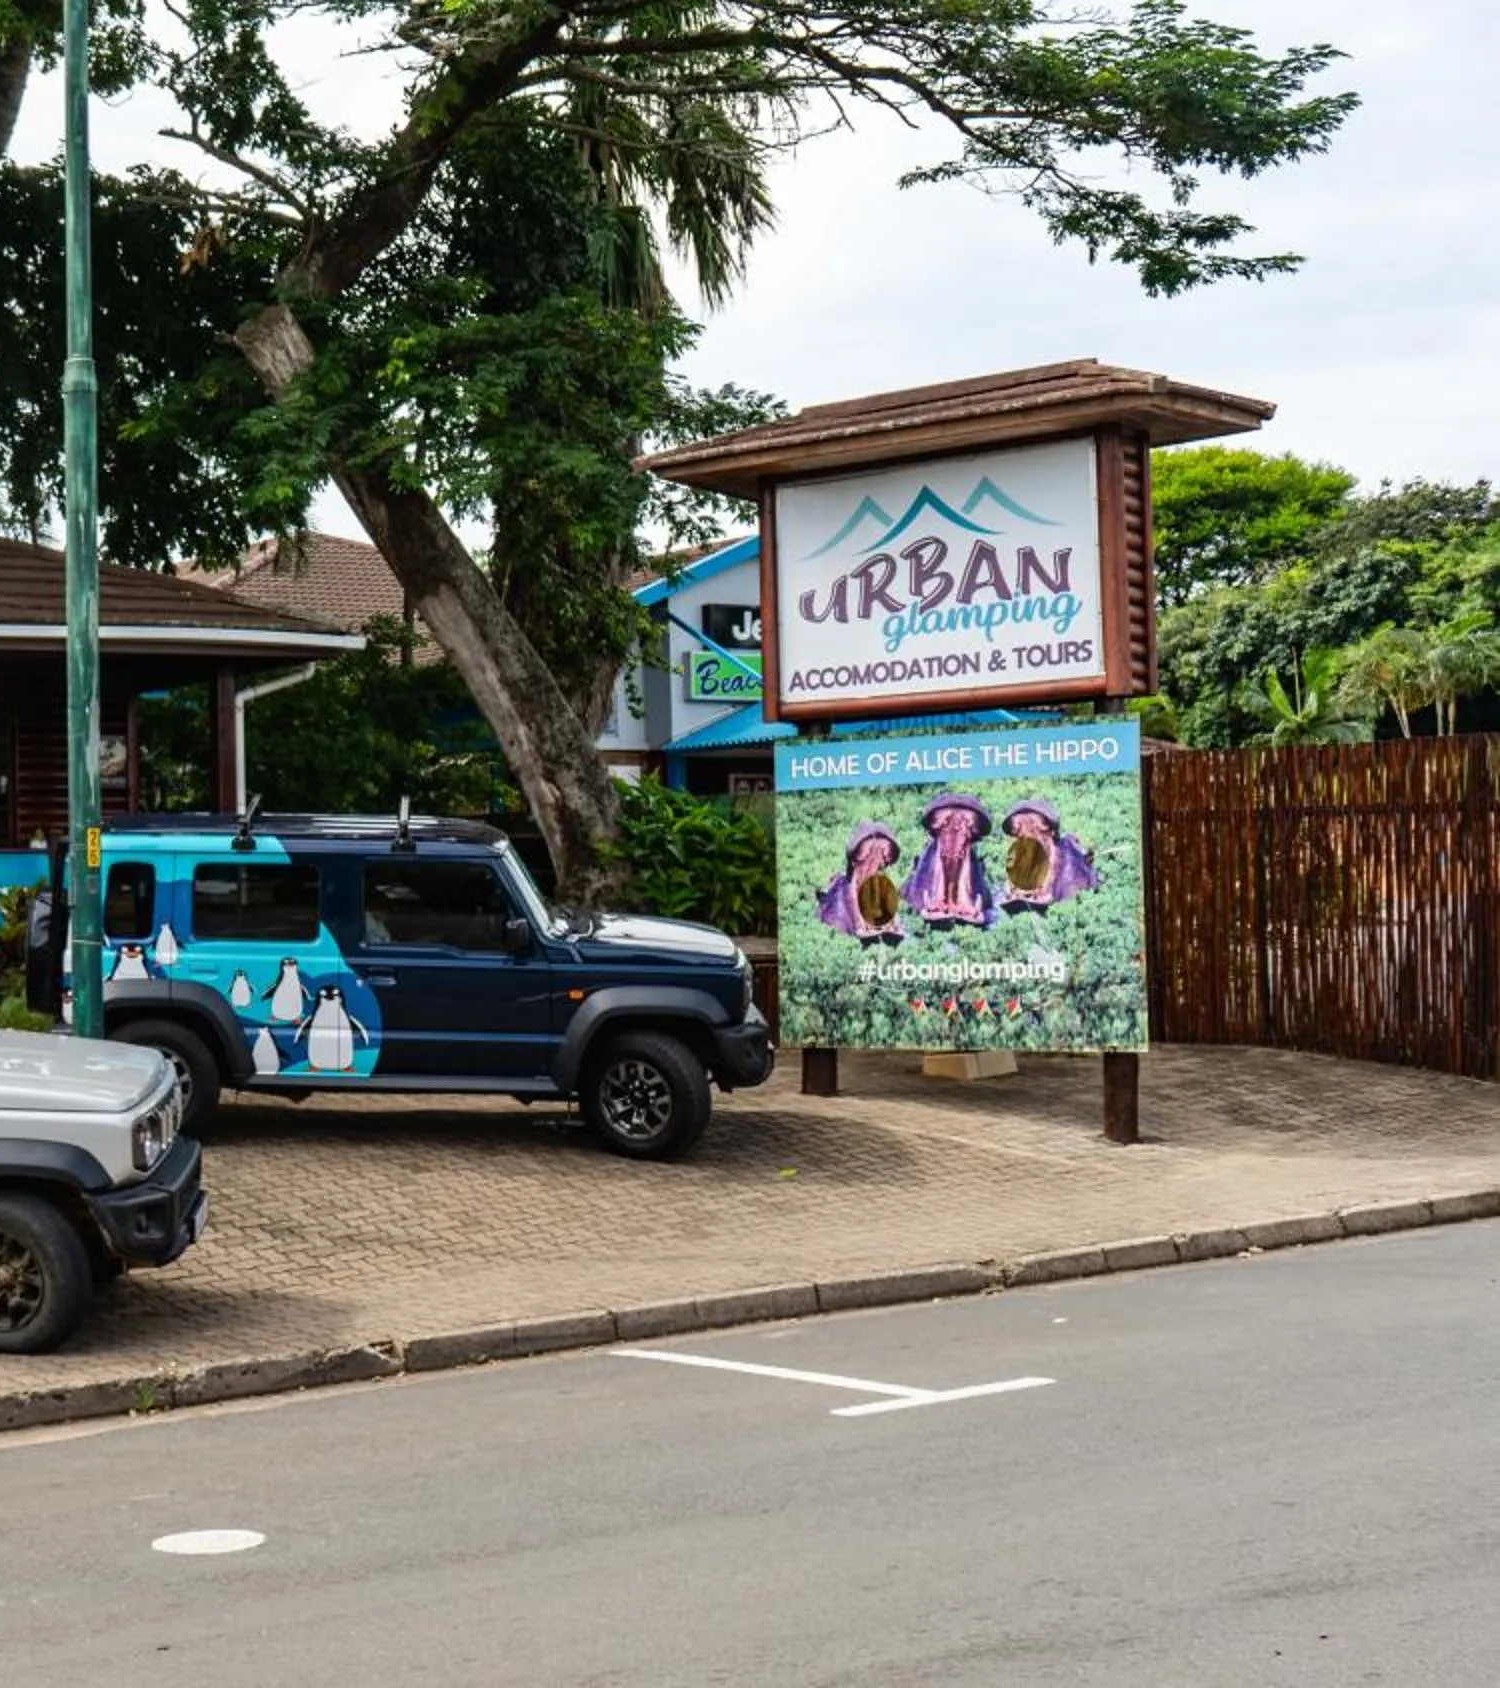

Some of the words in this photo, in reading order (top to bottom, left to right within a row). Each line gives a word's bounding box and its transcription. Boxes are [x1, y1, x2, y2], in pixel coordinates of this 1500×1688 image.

[798, 536, 1073, 623] URBAN
[882, 583, 1082, 653] glamping
[789, 651, 981, 693] ACCOMODATION
[987, 649, 1008, 673] &
[1012, 639, 1094, 670] TOURS
[791, 753, 861, 779] HOME
[866, 751, 899, 775] OF
[905, 746, 973, 772] ALICE
[979, 743, 1029, 767] THE
[1035, 736, 1120, 763] HIPPO
[857, 957, 1066, 984] #urbanglamping
